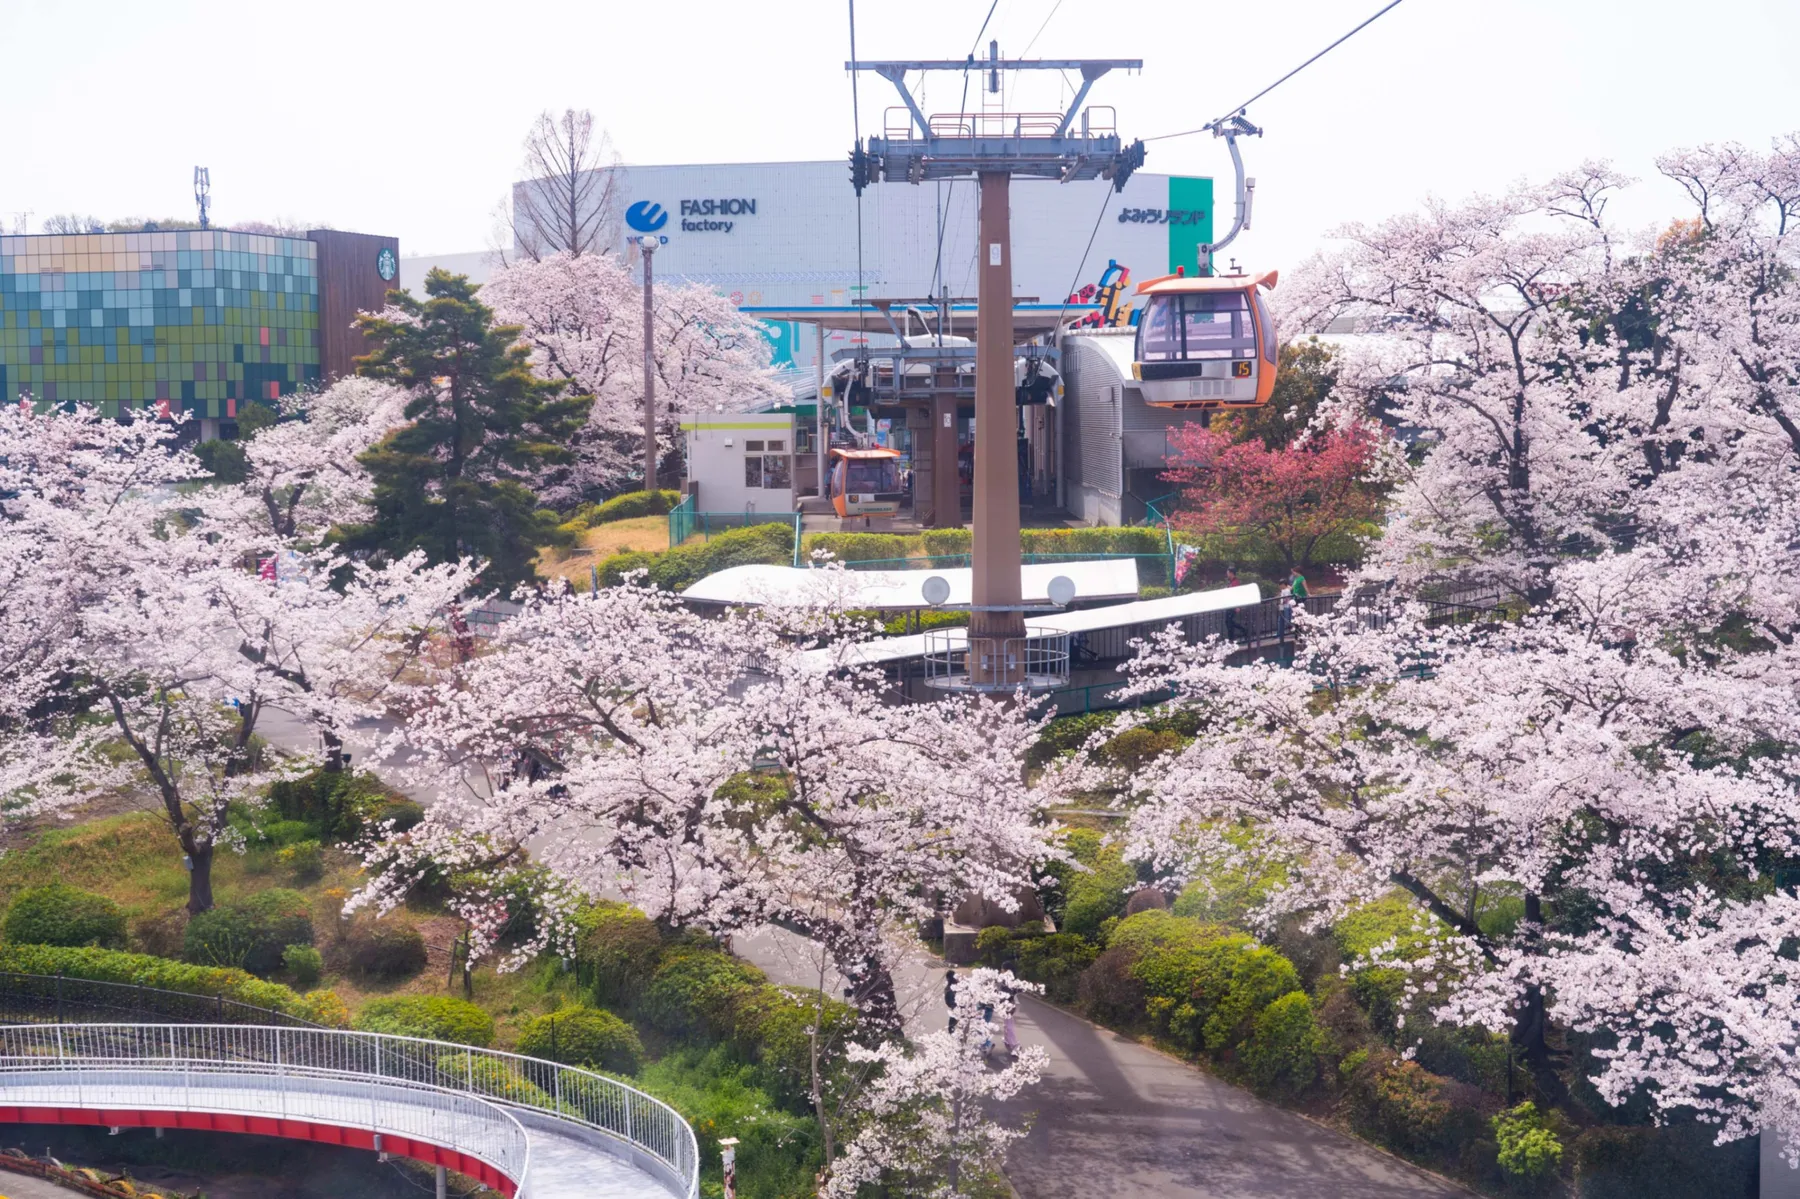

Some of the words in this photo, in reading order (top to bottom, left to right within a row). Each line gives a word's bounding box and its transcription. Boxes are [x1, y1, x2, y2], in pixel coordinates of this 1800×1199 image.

[680, 198, 756, 216] FASHION
[1118, 207, 1205, 226] よみうりランド
[681, 218, 733, 233] factory
[1238, 361, 1250, 376] 15
